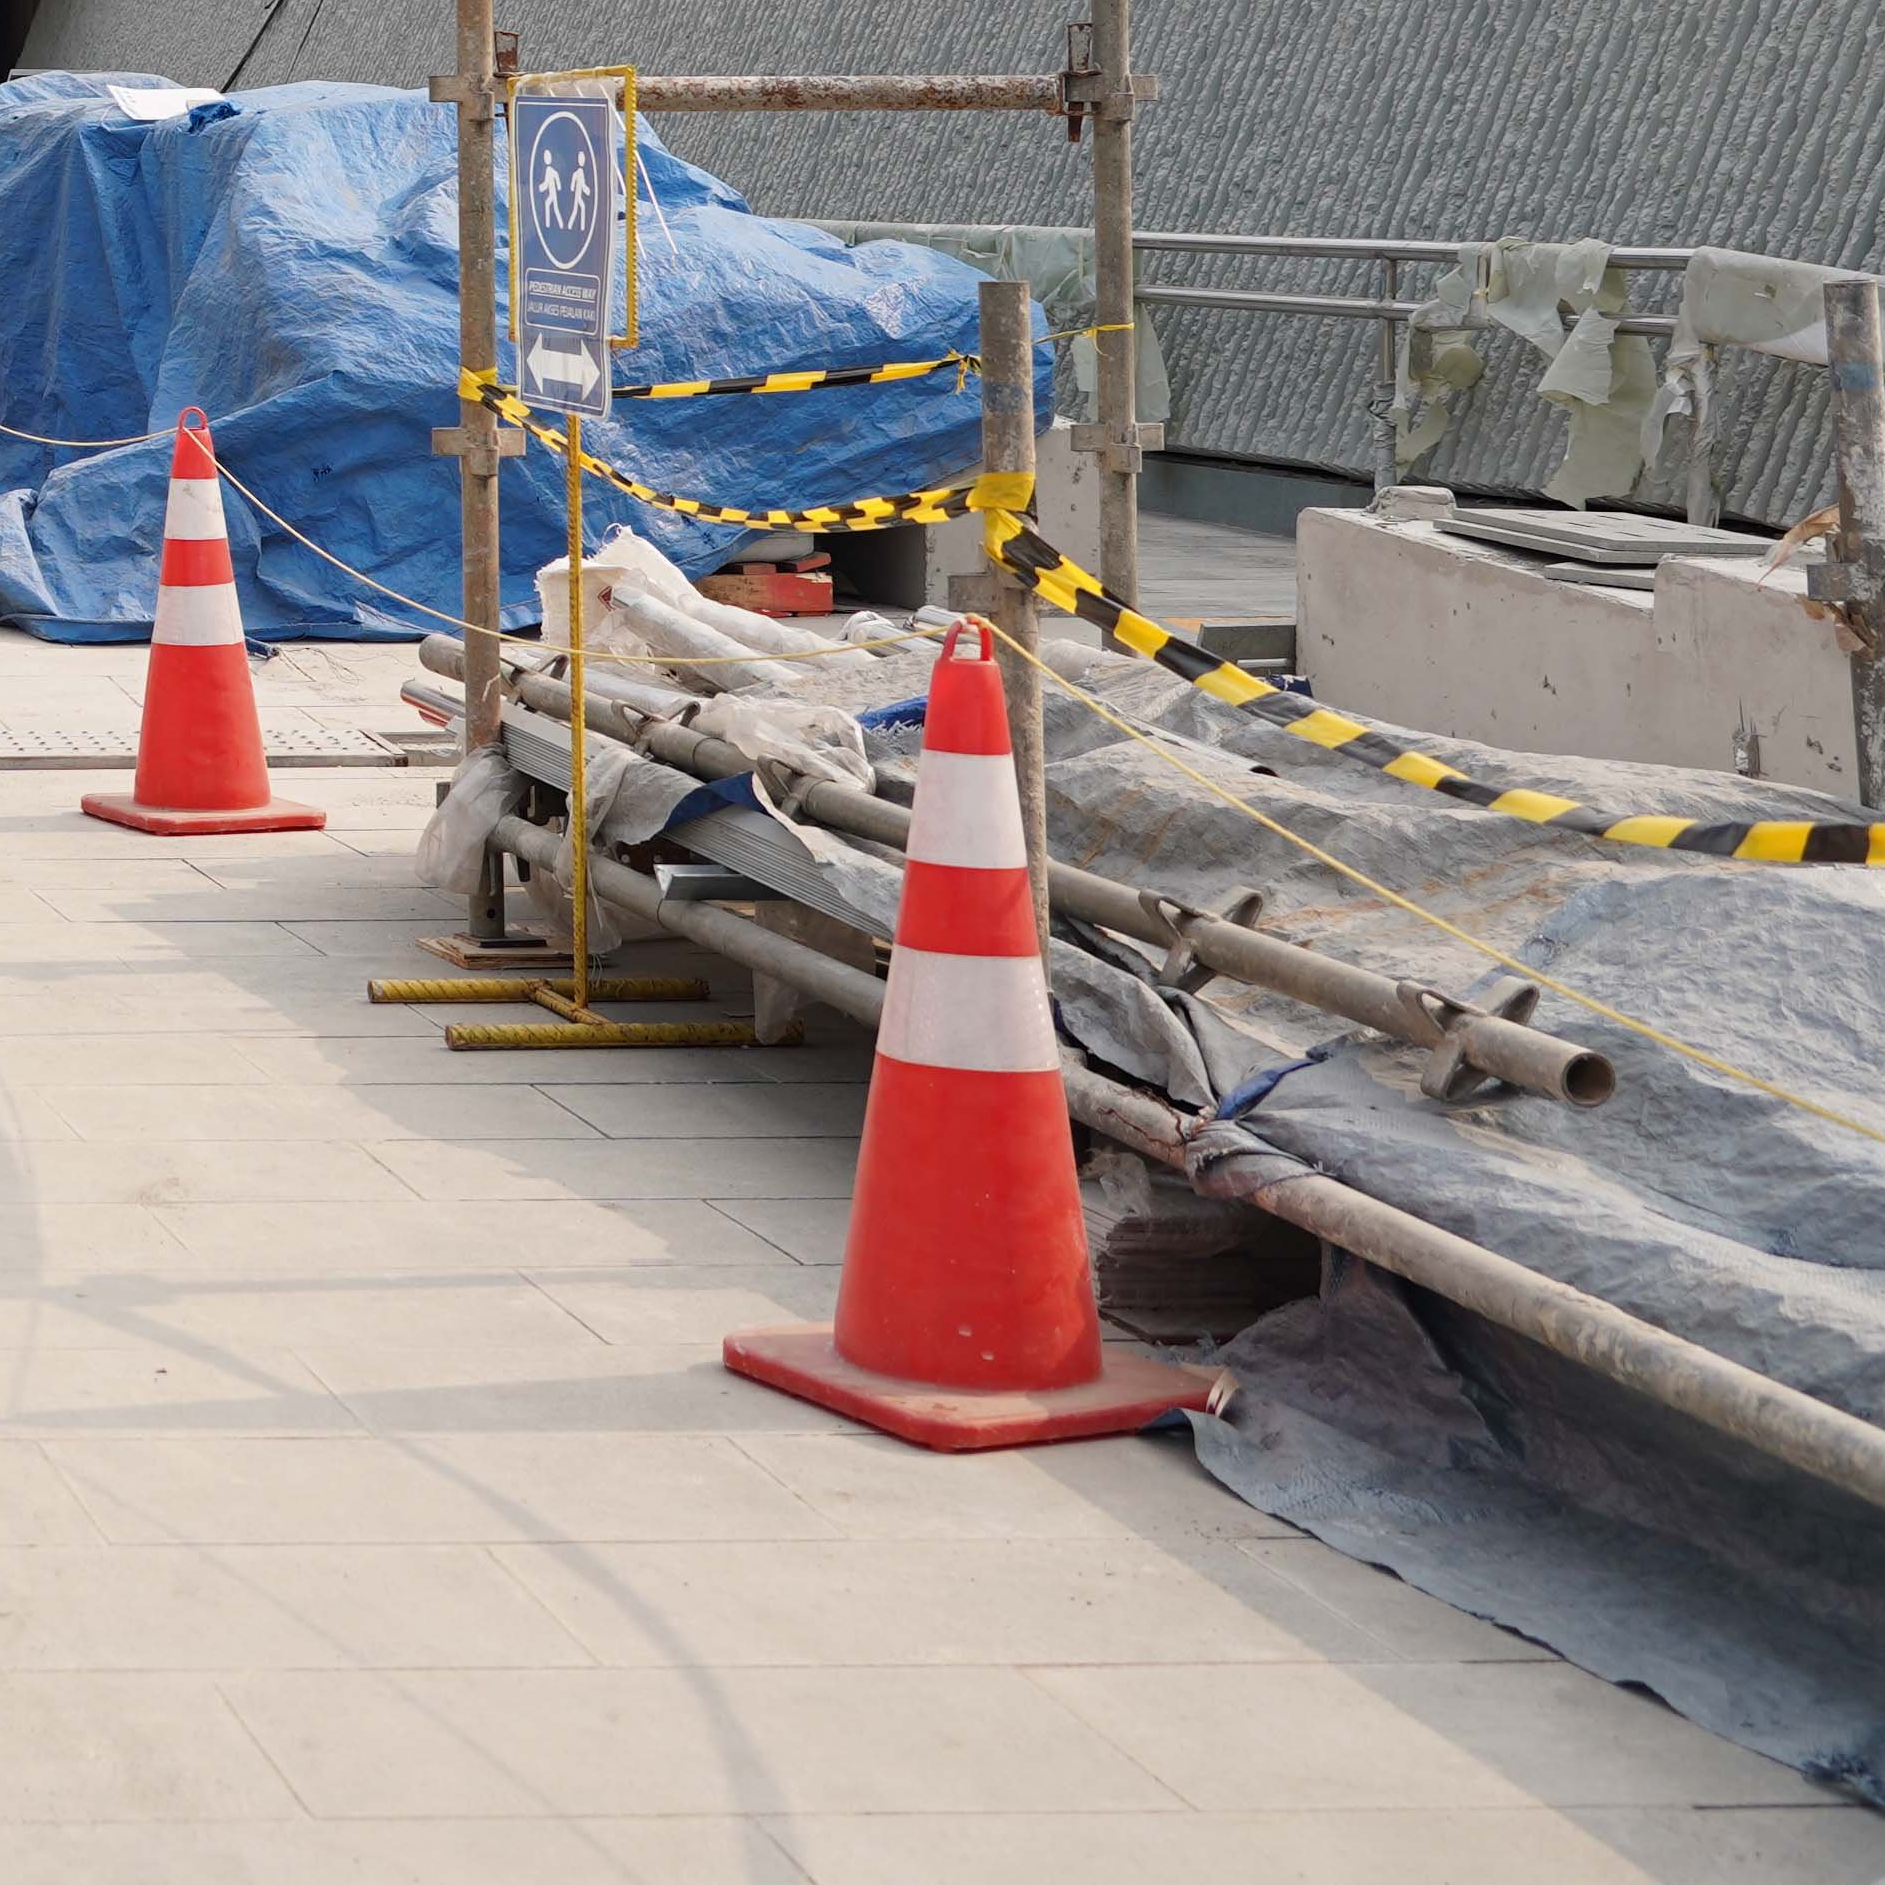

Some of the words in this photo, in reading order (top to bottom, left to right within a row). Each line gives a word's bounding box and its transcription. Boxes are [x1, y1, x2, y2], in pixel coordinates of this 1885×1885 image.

[529, 280, 562, 295] PEDESTRIAN
[562, 285, 581, 298] ACCESS
[581, 288, 596, 300] WAY
